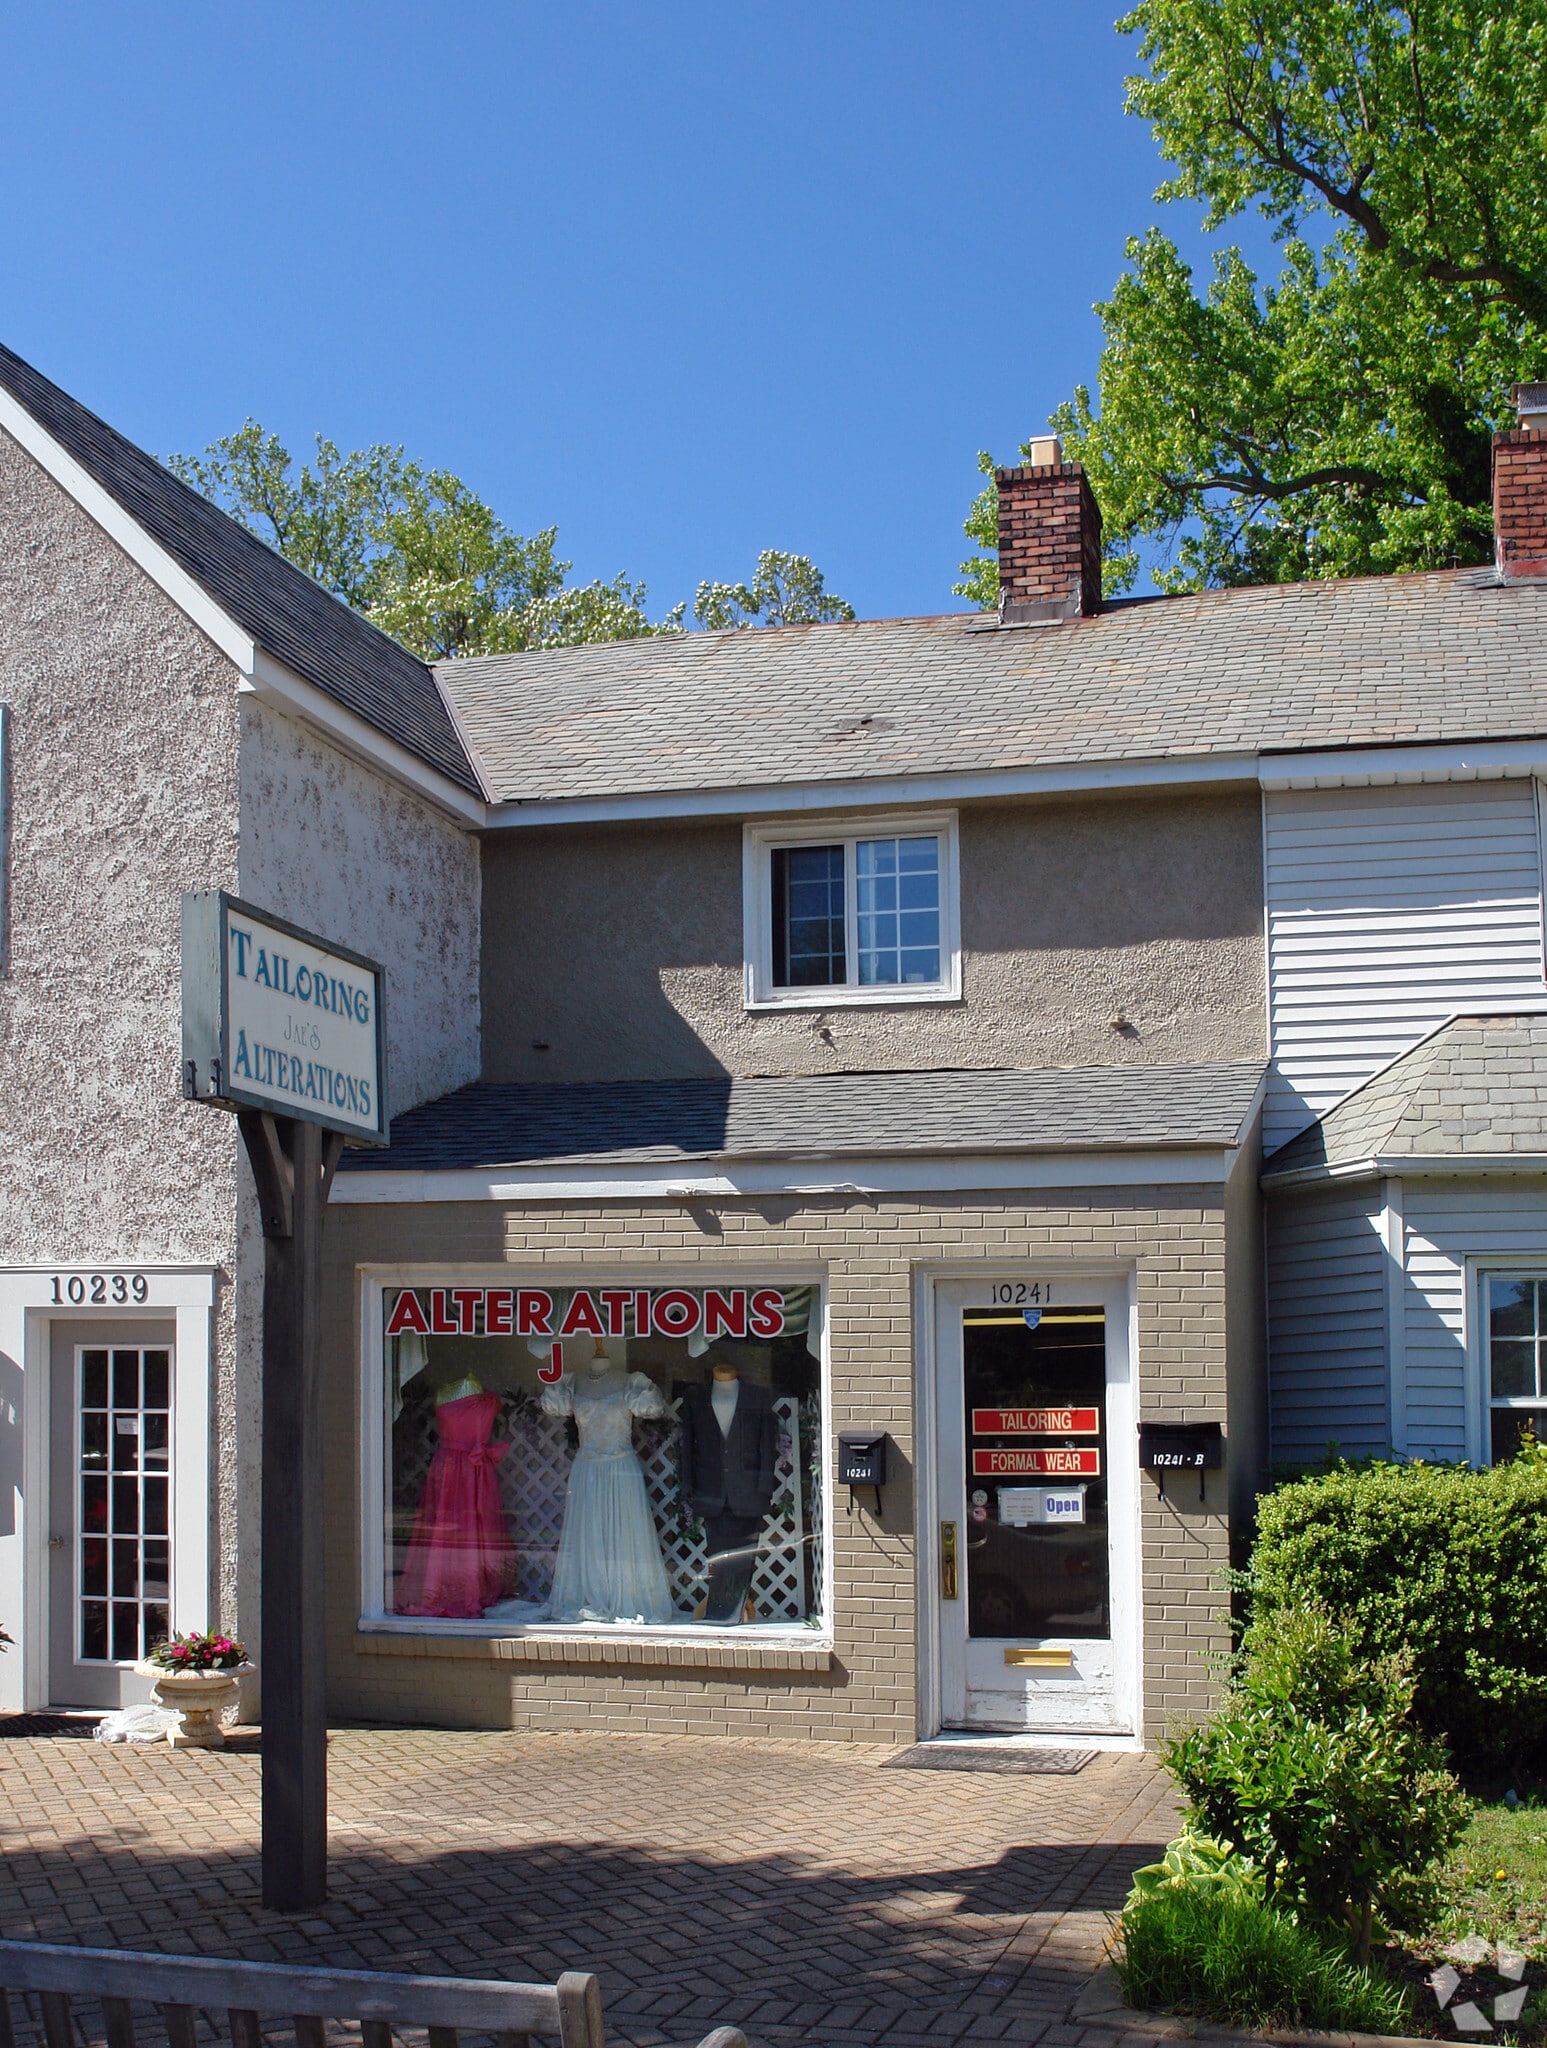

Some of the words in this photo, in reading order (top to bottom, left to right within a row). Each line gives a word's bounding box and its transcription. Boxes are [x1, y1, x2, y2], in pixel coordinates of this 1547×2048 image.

[230, 927, 370, 1024] TAILORING
[233, 1029, 371, 1116] ALTERATIONS
[50, 1275, 149, 1305] 10239
[992, 1283, 1051, 1304] 10241
[386, 1289, 785, 1338] ALTERATIONS
[537, 1341, 563, 1384] J
[999, 1412, 1072, 1430] TAILORING
[991, 1453, 1041, 1471] FORMAL
[1045, 1453, 1081, 1471] WEAR
[1153, 1453, 1184, 1465] 10241
[1194, 1453, 1205, 1465] B
[846, 1468, 871, 1478] 10241
[1046, 1498, 1080, 1514] Open
